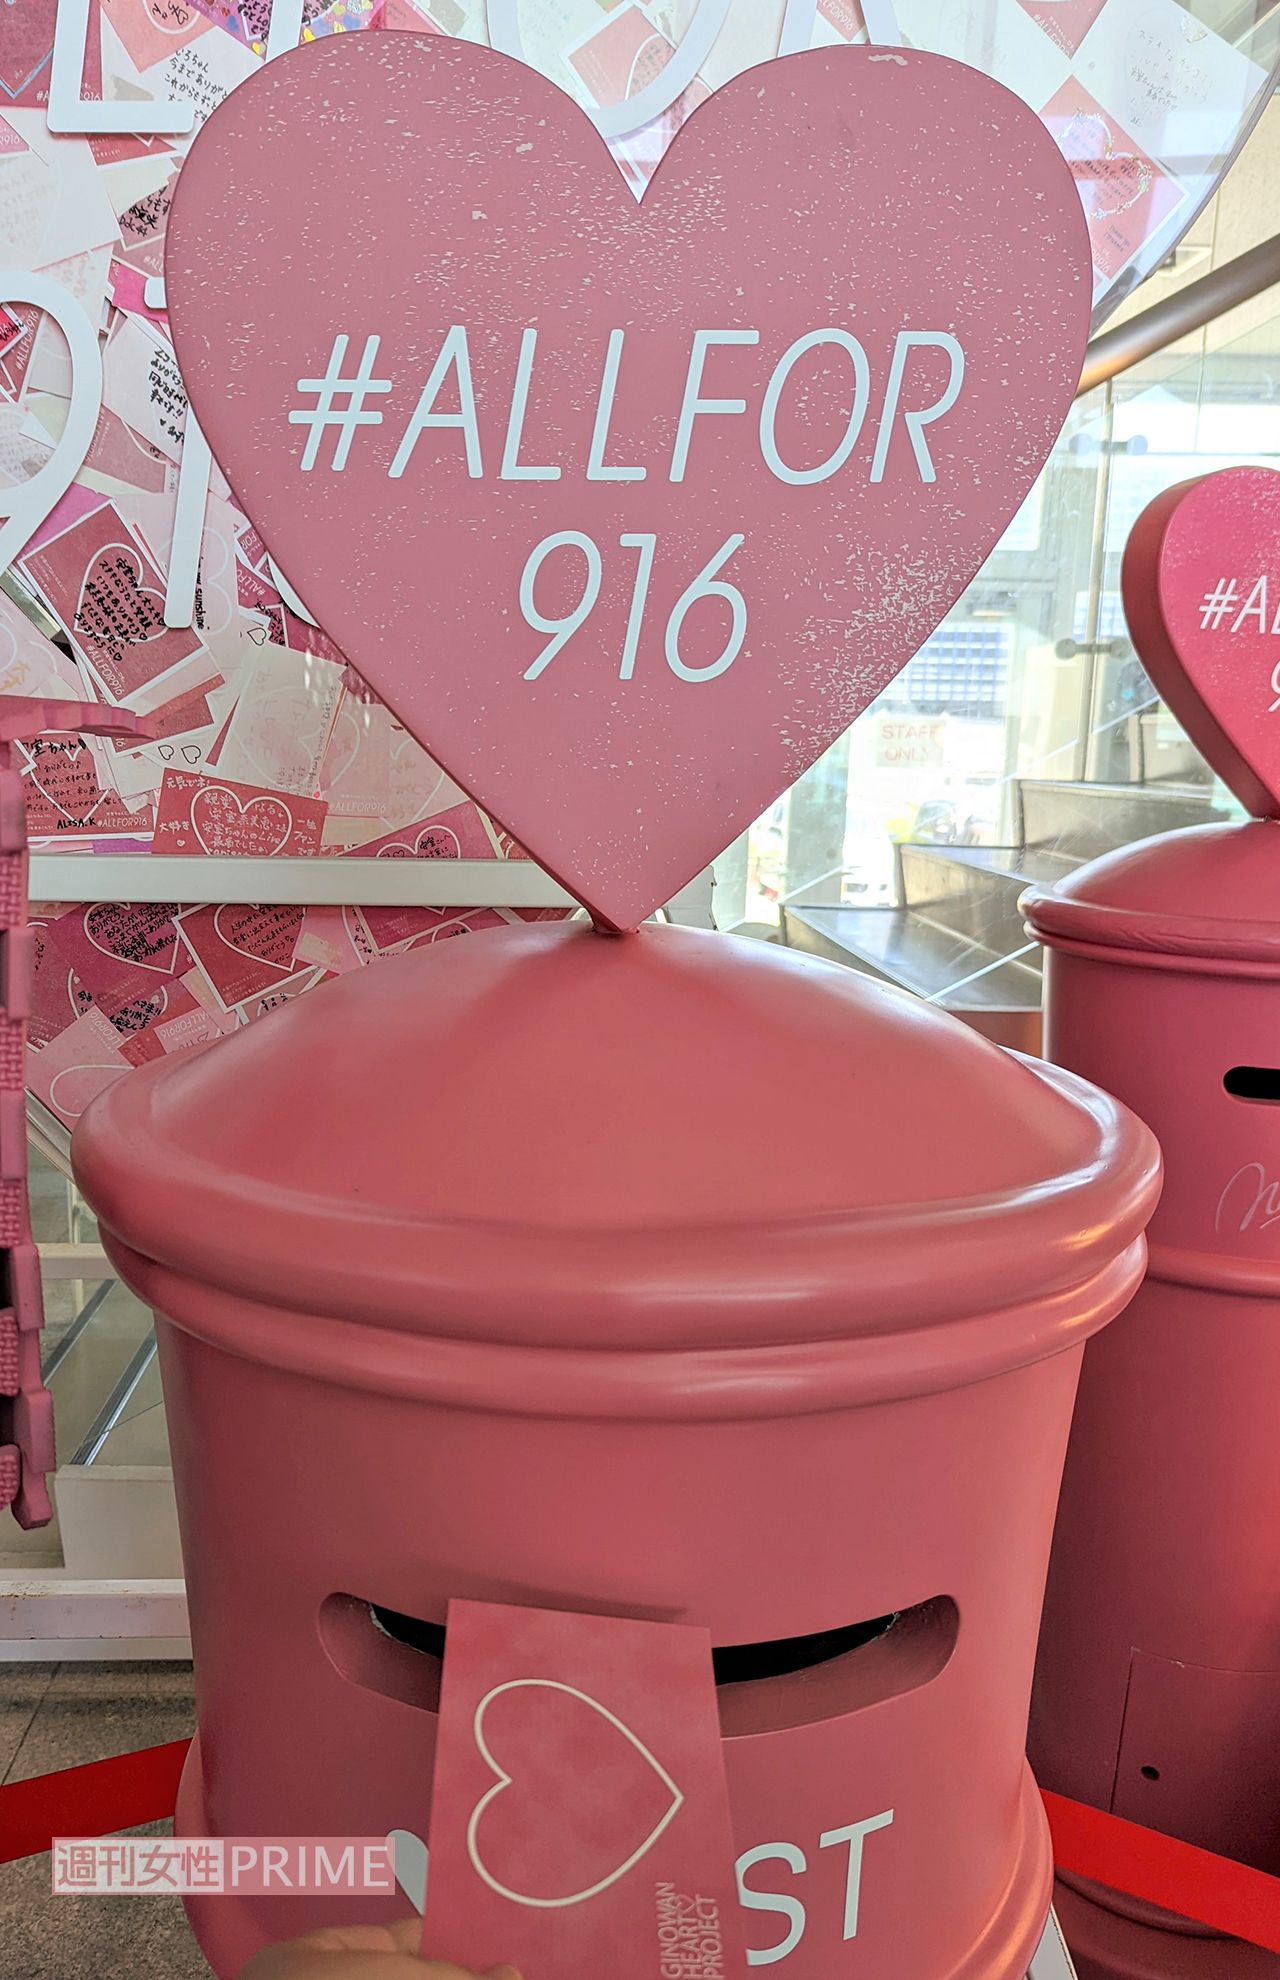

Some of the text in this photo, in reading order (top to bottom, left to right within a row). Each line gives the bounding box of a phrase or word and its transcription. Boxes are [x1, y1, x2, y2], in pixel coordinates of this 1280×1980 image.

[288, 325, 966, 486] #ALLFOR
[519, 530, 748, 683] 916
[86, 643, 123, 696] #ALLFOR916
[881, 724, 939, 740] STAFF
[96, 816, 147, 829] #ALLFOR916
[655, 1882, 683, 1979] GINOWAN
[677, 1917, 703, 1980] HEART
[695, 1894, 725, 1980] PROJECT
